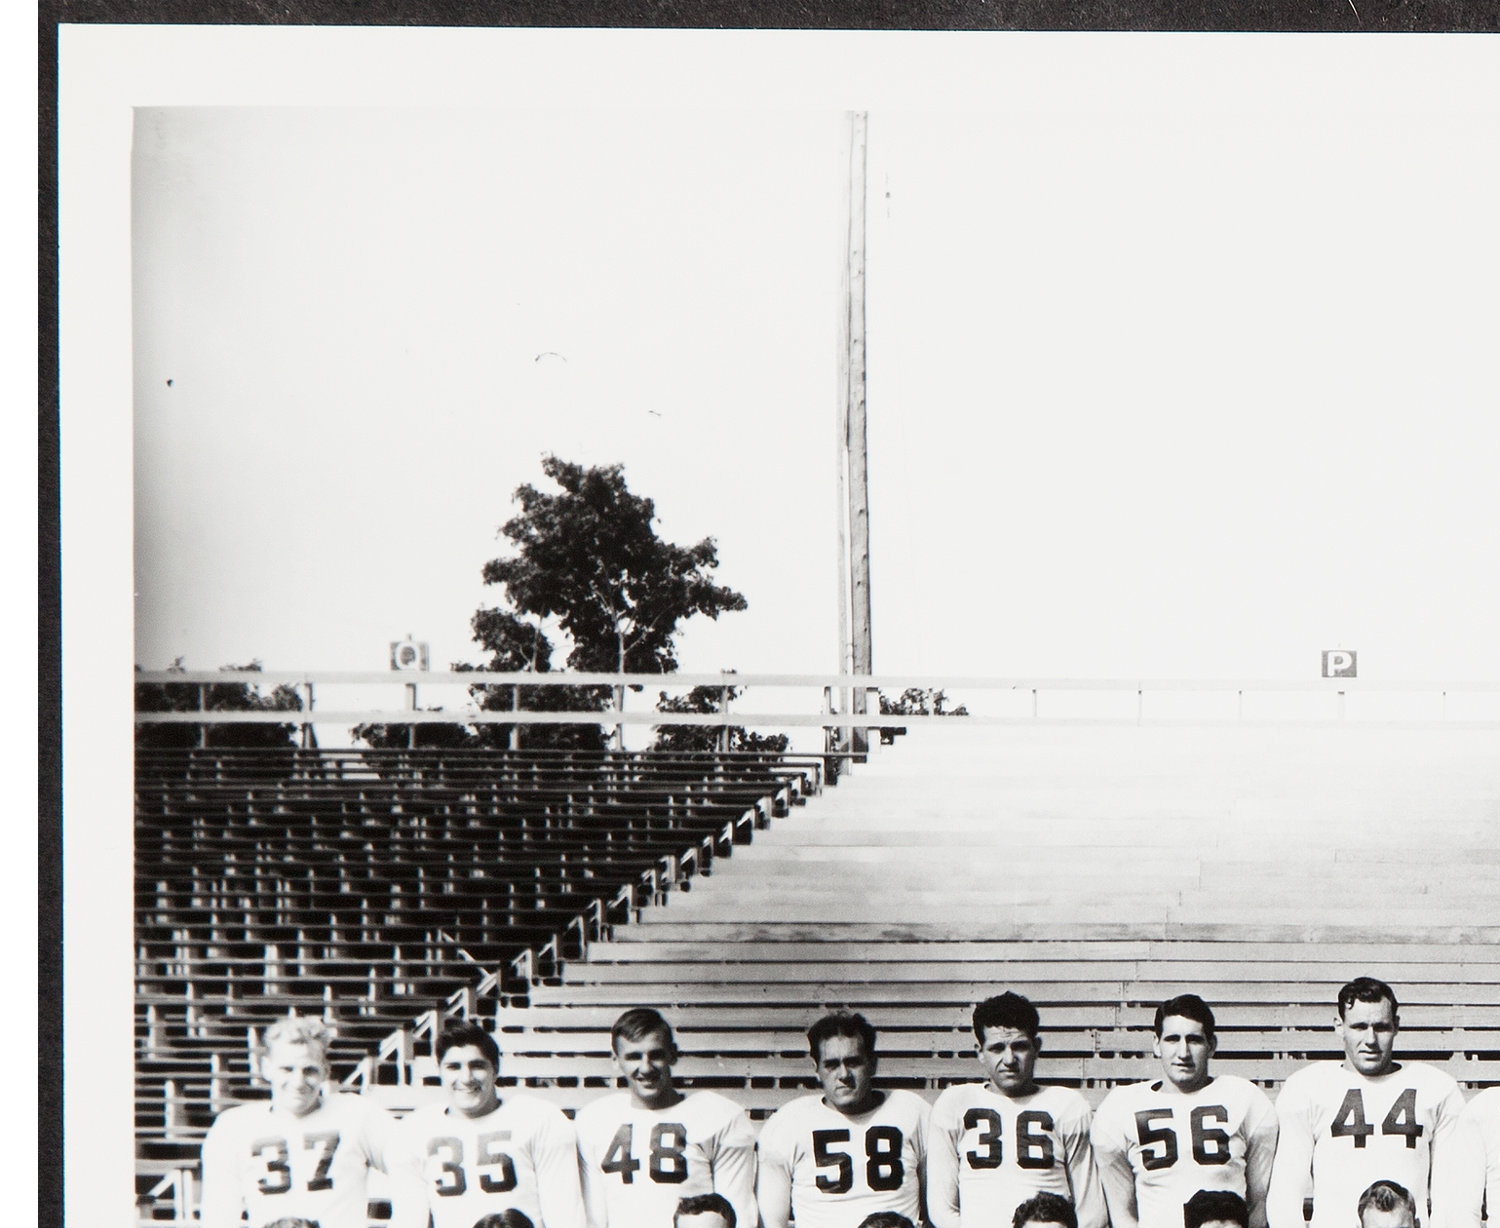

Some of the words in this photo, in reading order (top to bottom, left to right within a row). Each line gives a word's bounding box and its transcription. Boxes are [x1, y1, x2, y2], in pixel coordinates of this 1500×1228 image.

[1327, 651, 1353, 677] P
[963, 1108, 1055, 1169] 36
[1133, 1105, 1231, 1171] 56
[1330, 1088, 1424, 1148] 44
[250, 1131, 342, 1196] 37
[427, 1130, 518, 1197] 35
[600, 1122, 688, 1185] 48
[813, 1126, 903, 1192] 58
